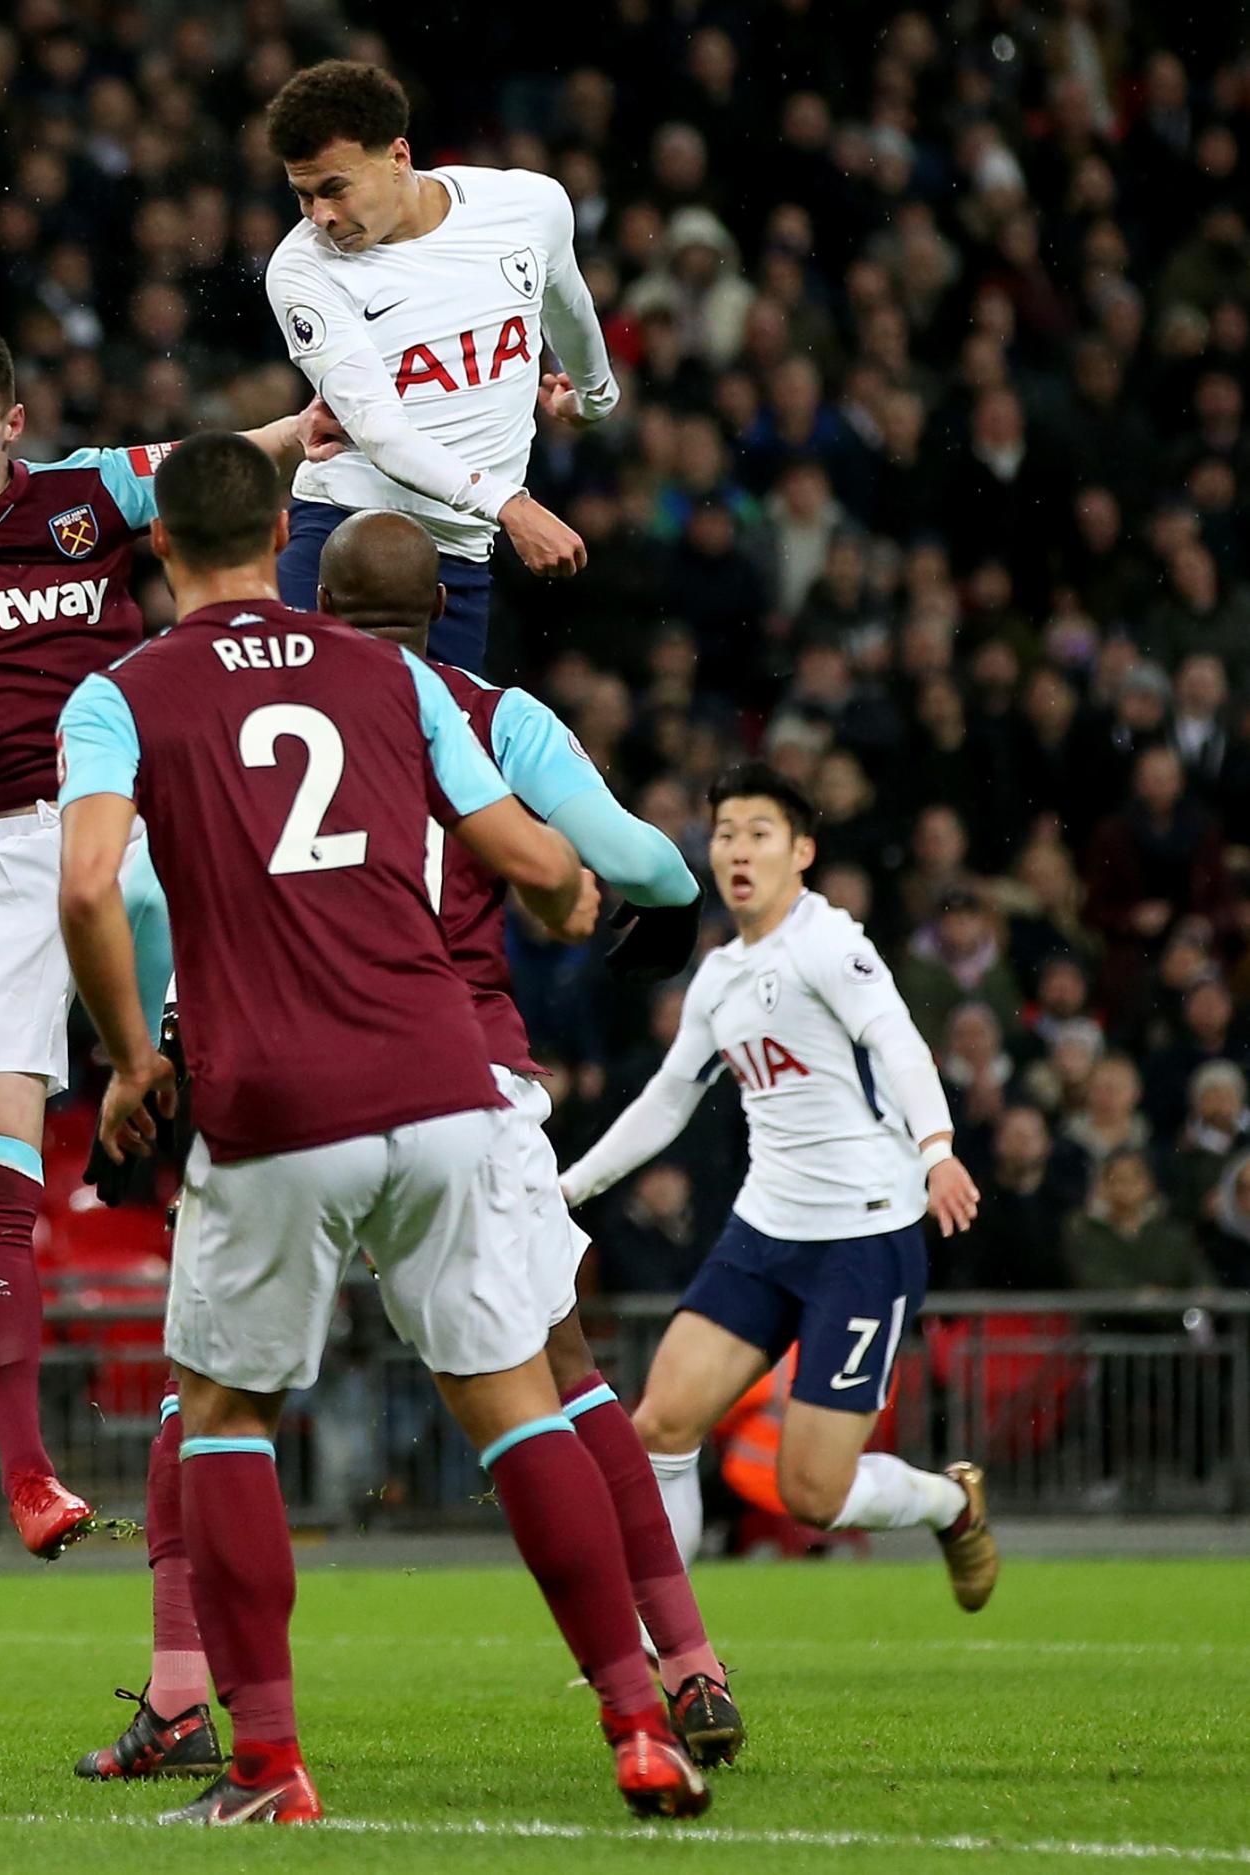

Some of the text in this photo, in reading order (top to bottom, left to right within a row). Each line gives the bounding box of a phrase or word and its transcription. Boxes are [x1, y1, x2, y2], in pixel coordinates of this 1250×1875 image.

[395, 315, 532, 399] AIA
[212, 633, 315, 672] REID
[238, 703, 368, 875] 2
[847, 1316, 881, 1374] 7
